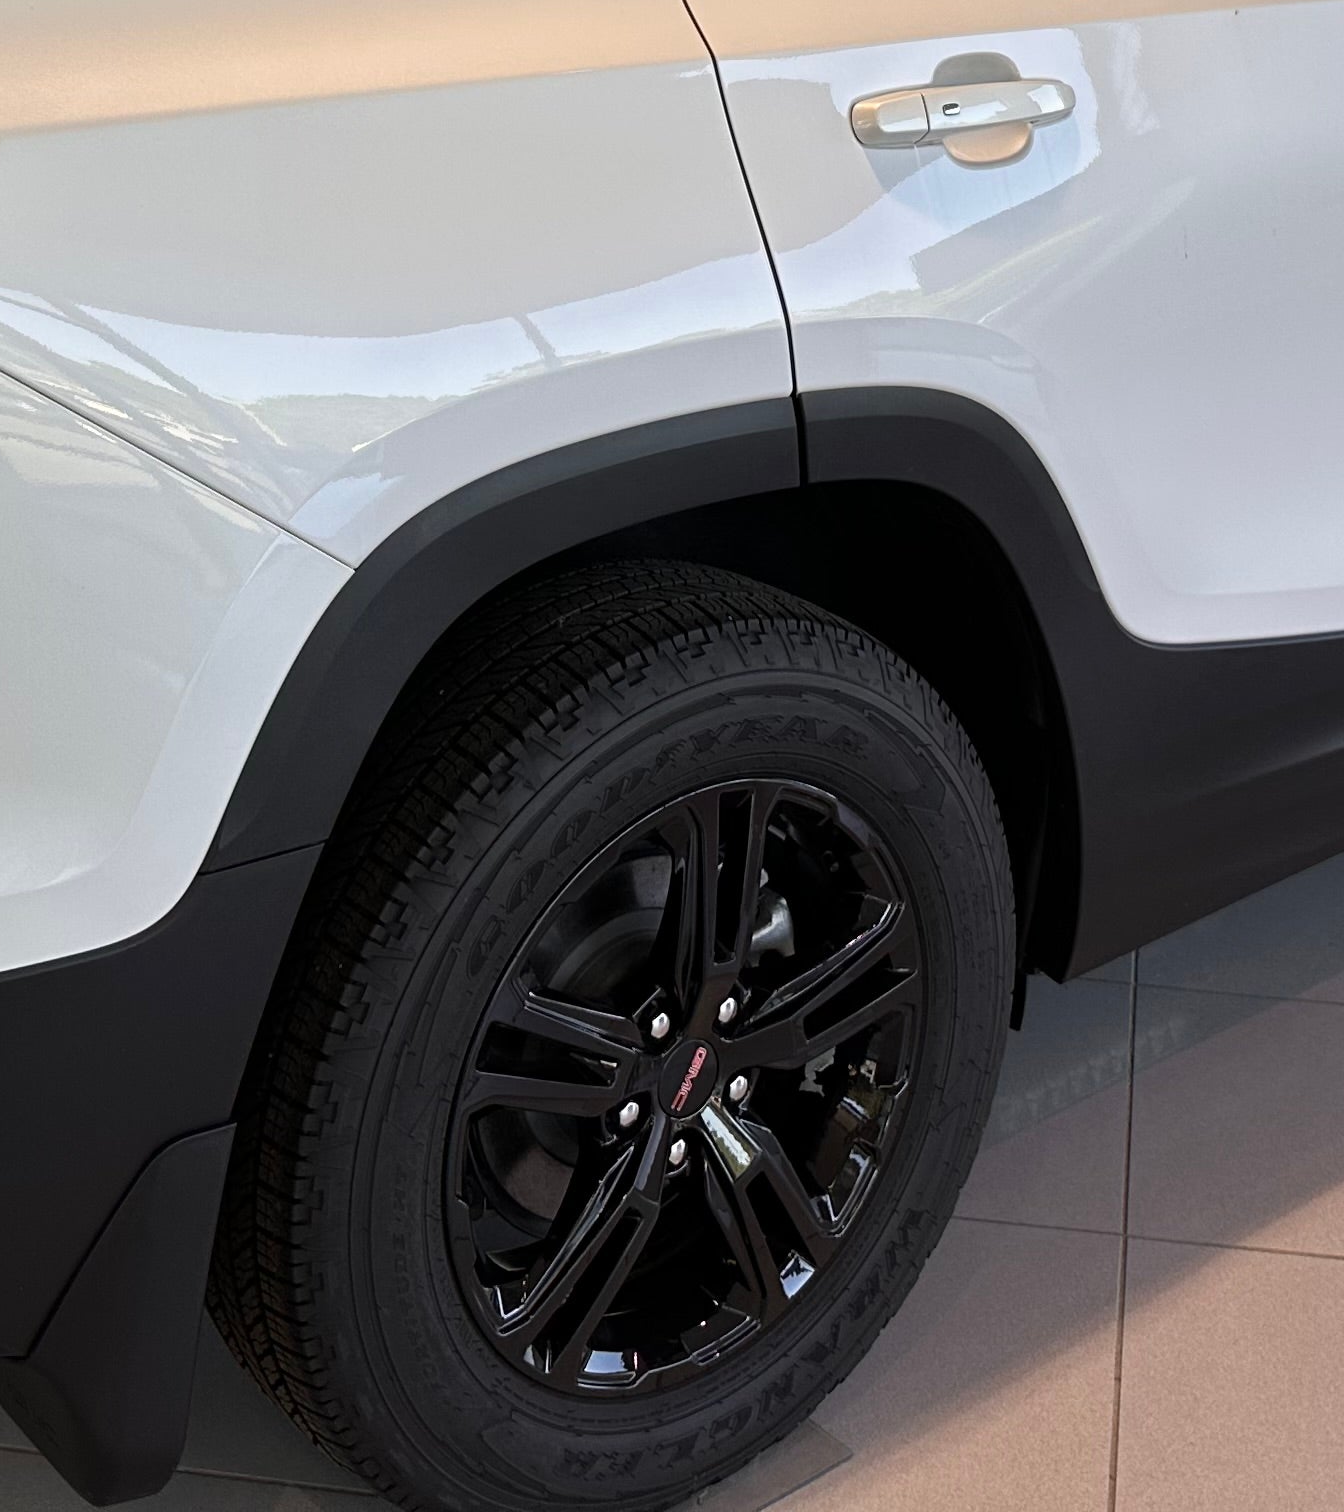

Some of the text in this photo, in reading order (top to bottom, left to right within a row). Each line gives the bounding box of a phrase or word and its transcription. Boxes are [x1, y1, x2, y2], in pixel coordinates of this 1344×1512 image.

[467, 713, 872, 980] GOODYEAR
[670, 1046, 708, 1113] GMC
[562, 1207, 940, 1483] WRANGLER
